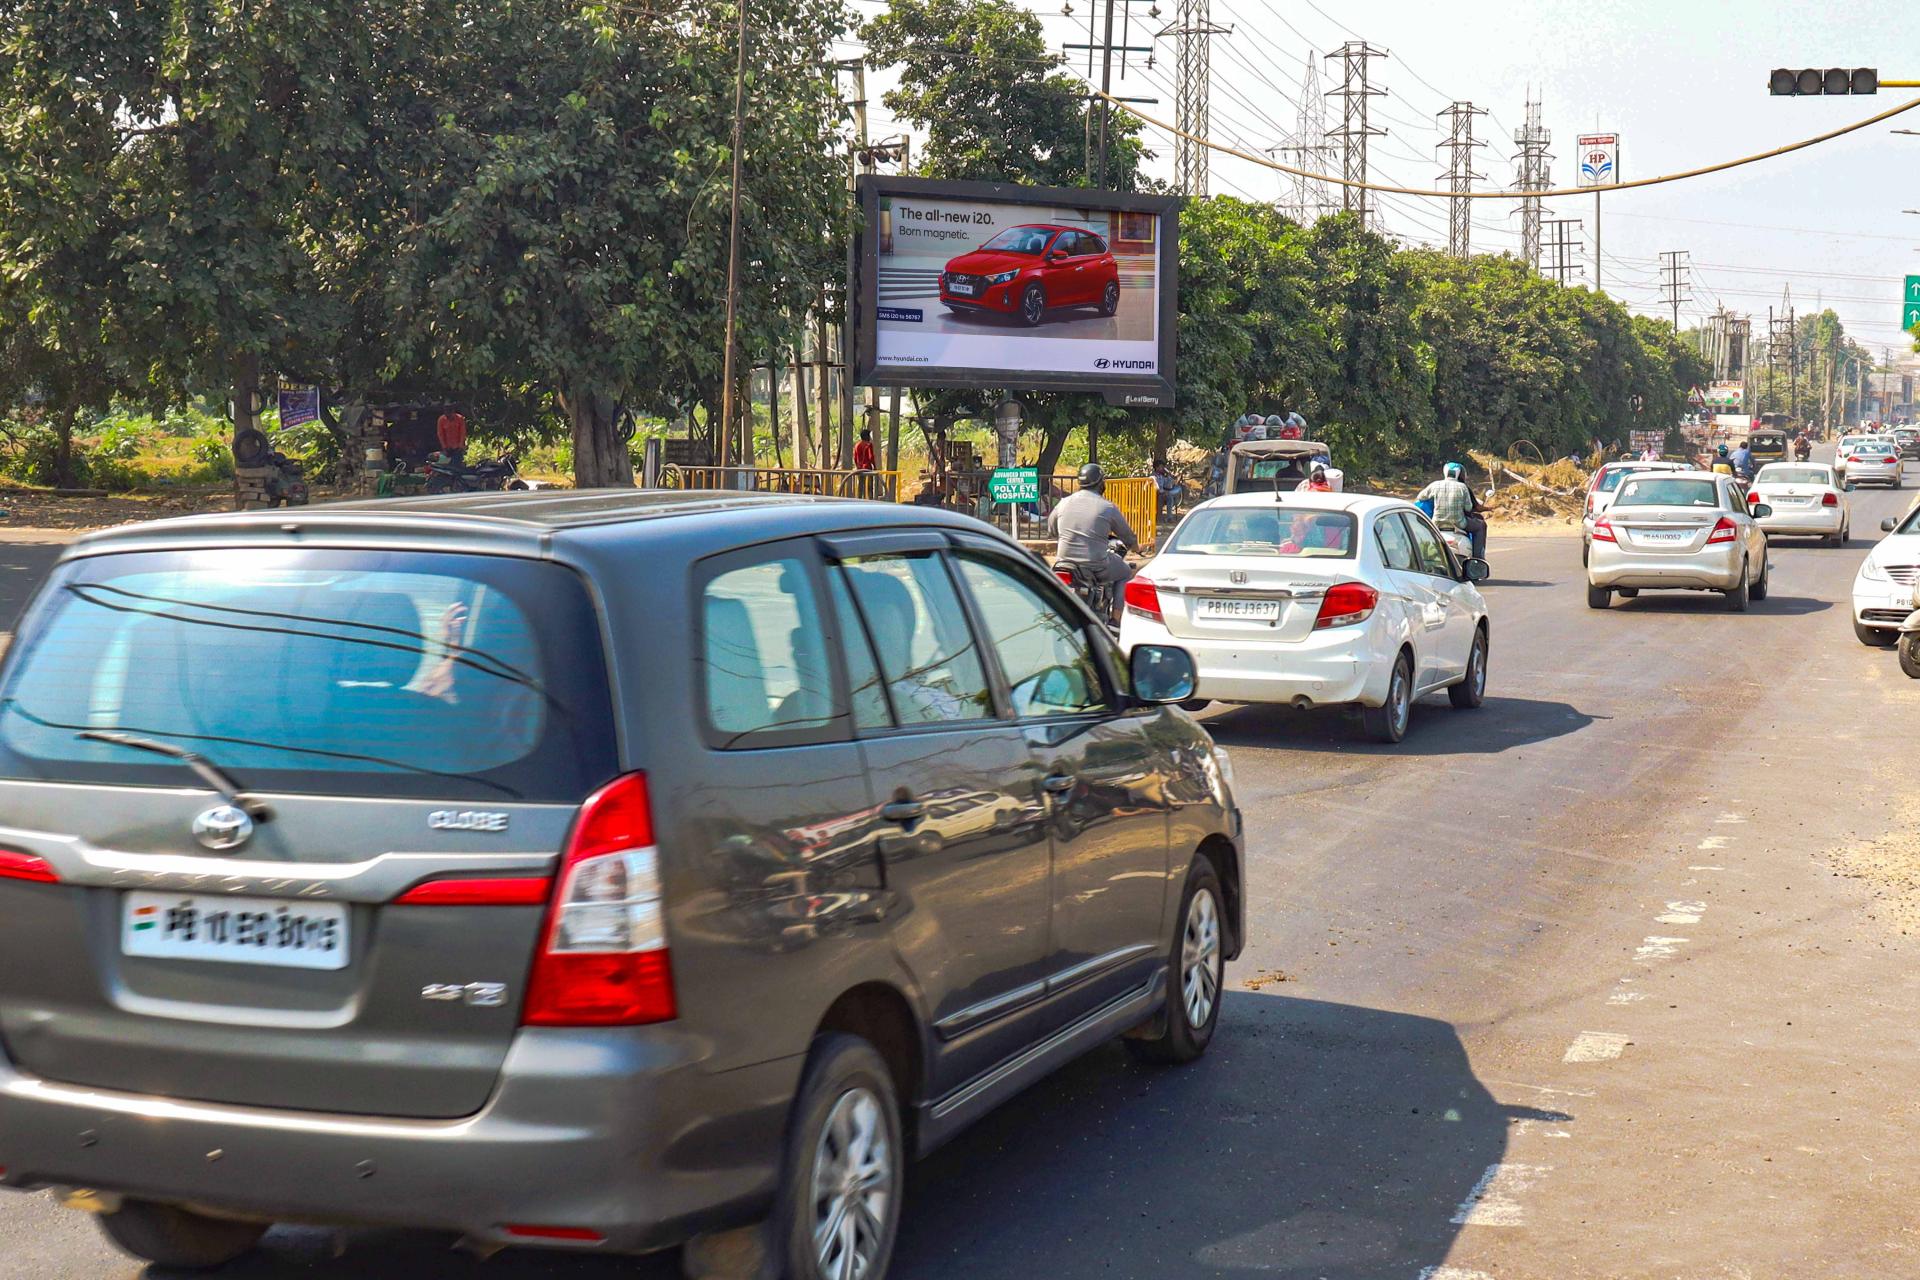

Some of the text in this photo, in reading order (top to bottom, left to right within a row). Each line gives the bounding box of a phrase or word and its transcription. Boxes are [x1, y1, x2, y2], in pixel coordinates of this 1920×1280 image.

[1589, 153, 1606, 164] HP
[899, 207, 995, 225] The all-new i20.
[899, 225, 970, 241] Born magnetic.
[878, 355, 929, 363] www.hyundai.co.in
[1112, 360, 1155, 370] HYUNDAI
[993, 484, 1038, 493] POLY EYE
[996, 492, 1035, 500] HOSPITAL
[1207, 601, 1277, 616] PB10EJ3637
